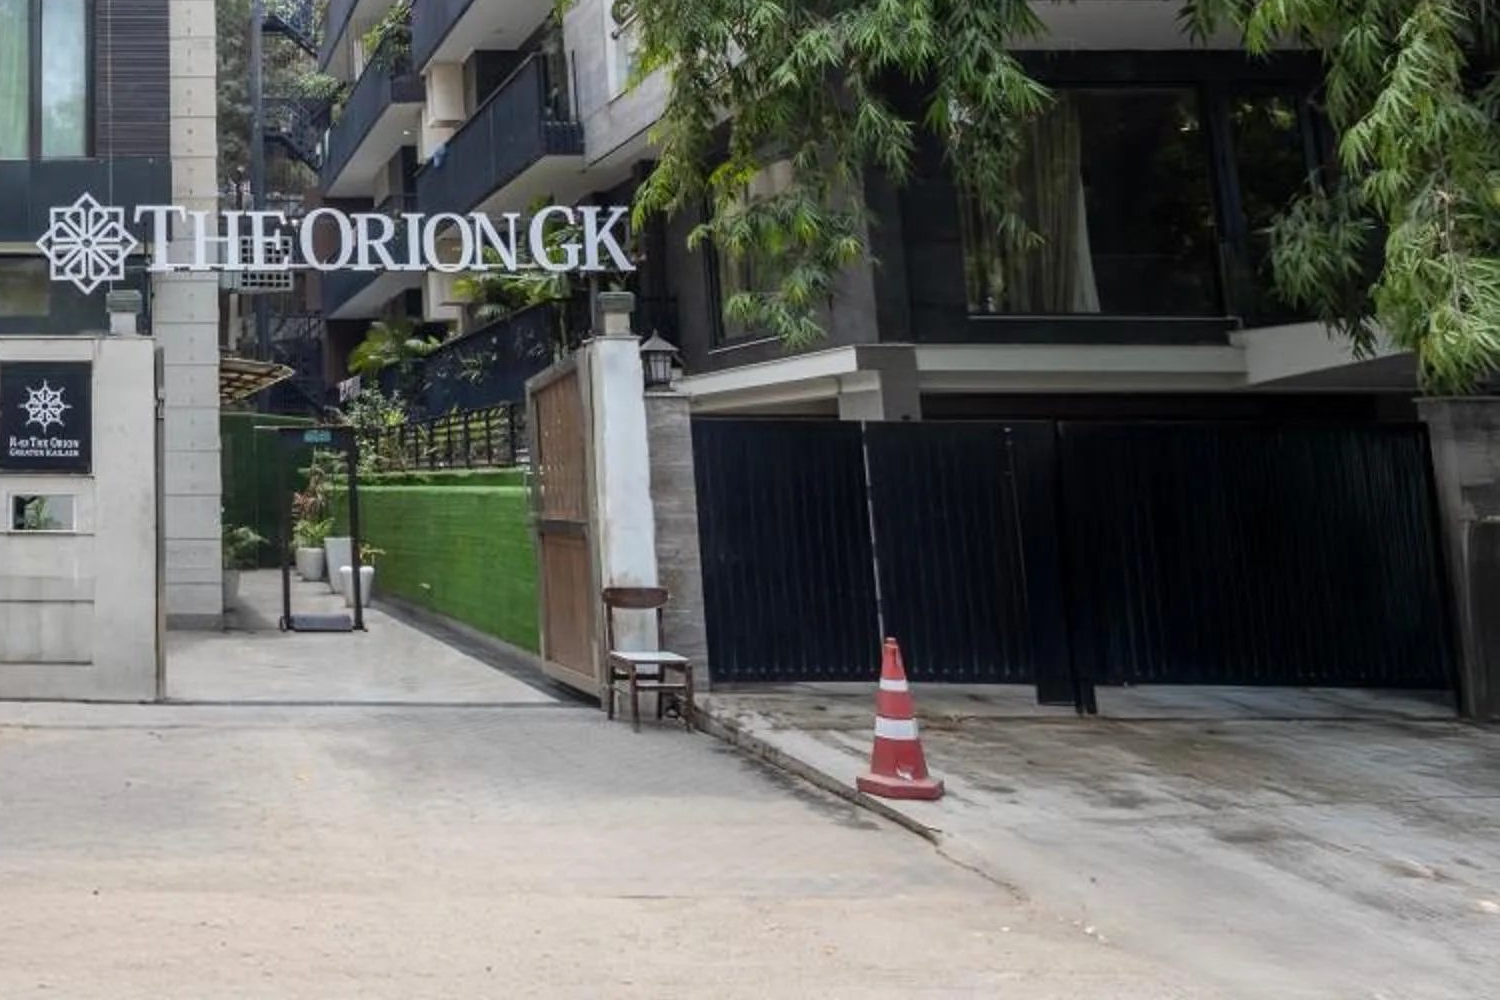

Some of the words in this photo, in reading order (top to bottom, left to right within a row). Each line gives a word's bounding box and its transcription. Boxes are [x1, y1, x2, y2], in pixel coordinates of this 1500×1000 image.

[134, 204, 292, 272] THE
[300, 206, 523, 272] ORION
[528, 204, 636, 272] GK
